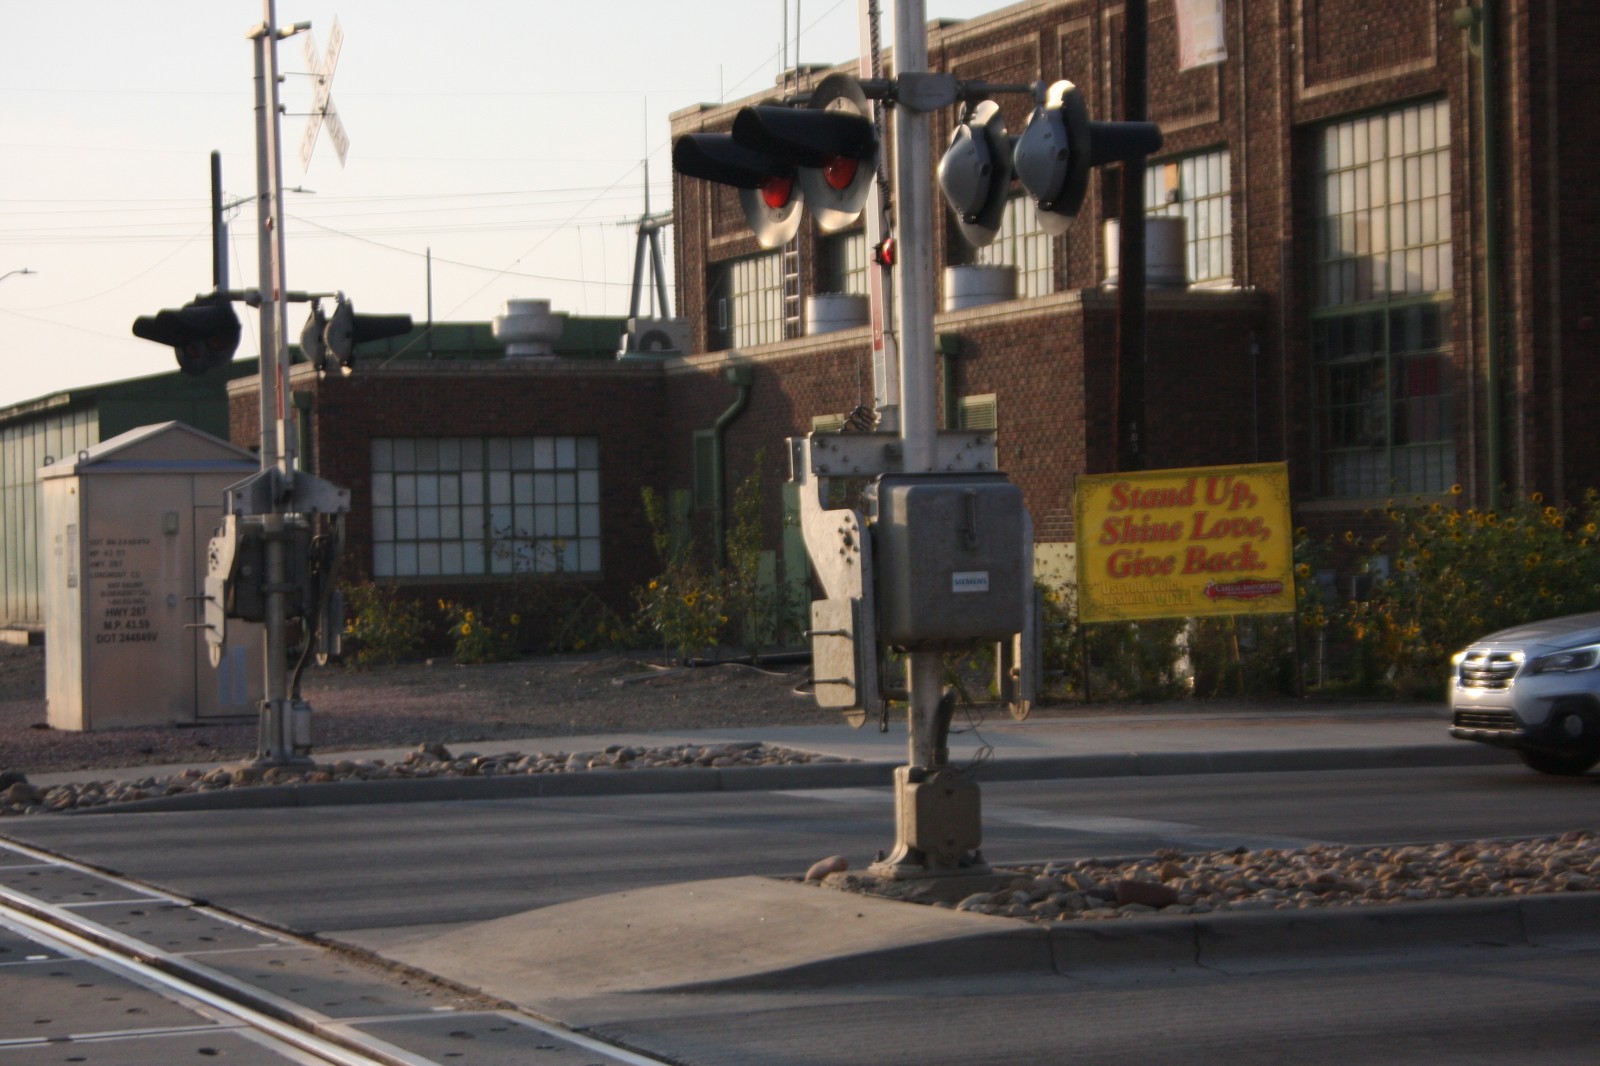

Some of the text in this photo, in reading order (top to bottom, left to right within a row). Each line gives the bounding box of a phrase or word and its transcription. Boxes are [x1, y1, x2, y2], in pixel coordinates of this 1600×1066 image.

[1109, 474, 1259, 511] Stand Up,
[1100, 510, 1272, 545] Shine Love,
[1107, 541, 1268, 578] Give Back.
[106, 608, 128, 616] HWY
[97, 634, 115, 643] DOT
